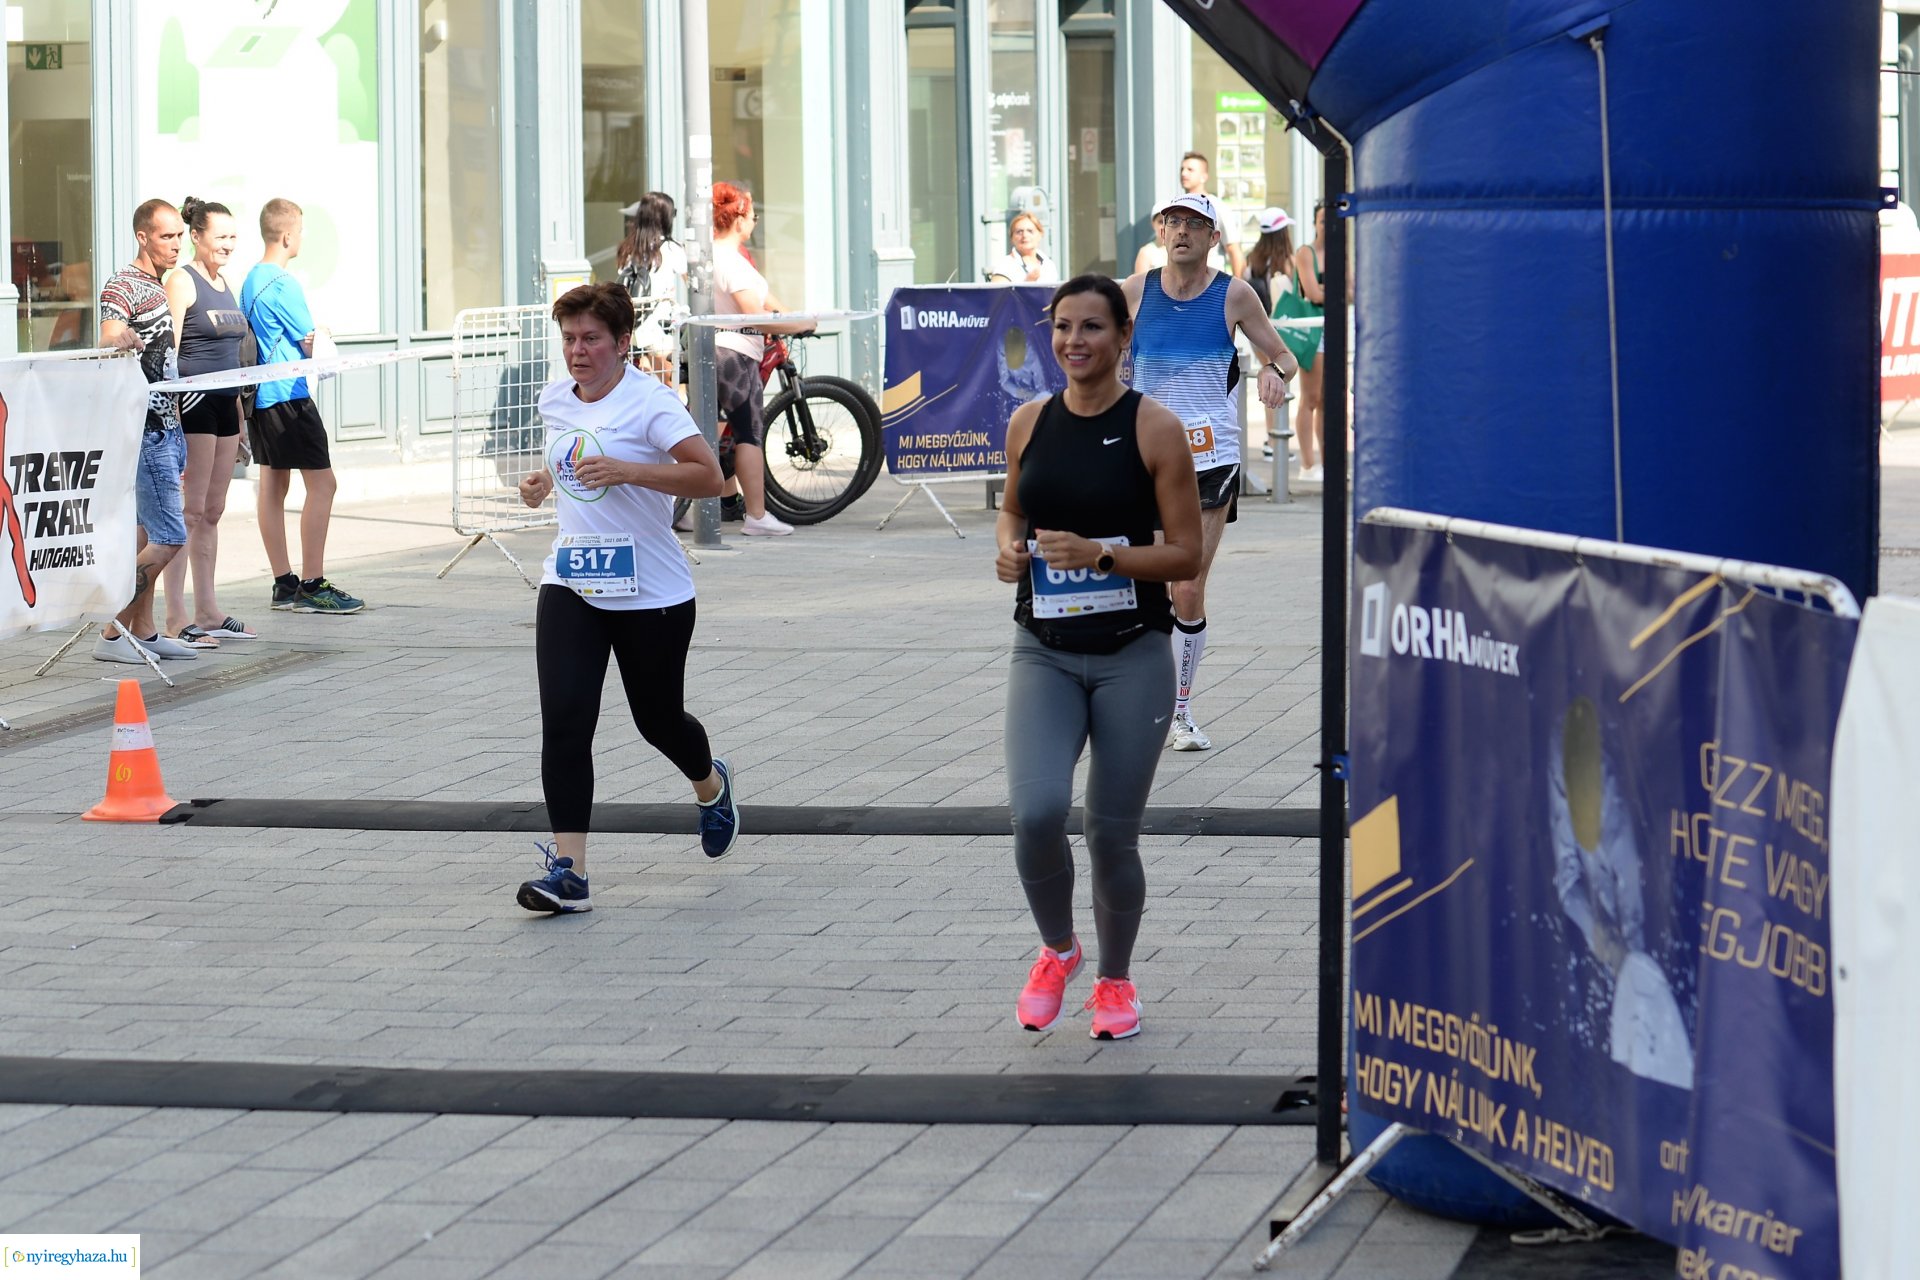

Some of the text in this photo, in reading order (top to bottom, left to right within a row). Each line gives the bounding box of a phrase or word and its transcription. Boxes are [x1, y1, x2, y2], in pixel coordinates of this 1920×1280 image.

[899, 431, 991, 449] MI MEGGYŐZÜNK,
[897, 454, 928, 469] HOGY
[930, 450, 975, 467] NÁLUNK
[977, 452, 985, 465] A
[24, 498, 94, 539] TRAIL
[29, 545, 83, 571] HUNGARY
[569, 548, 616, 570] 517
[1765, 843, 1830, 921] VAGY
[1354, 990, 1383, 1037] MI
[1355, 1052, 1422, 1110] HOGY
[1511, 1109, 1529, 1155] A
[1533, 1115, 1615, 1193] HELYED
